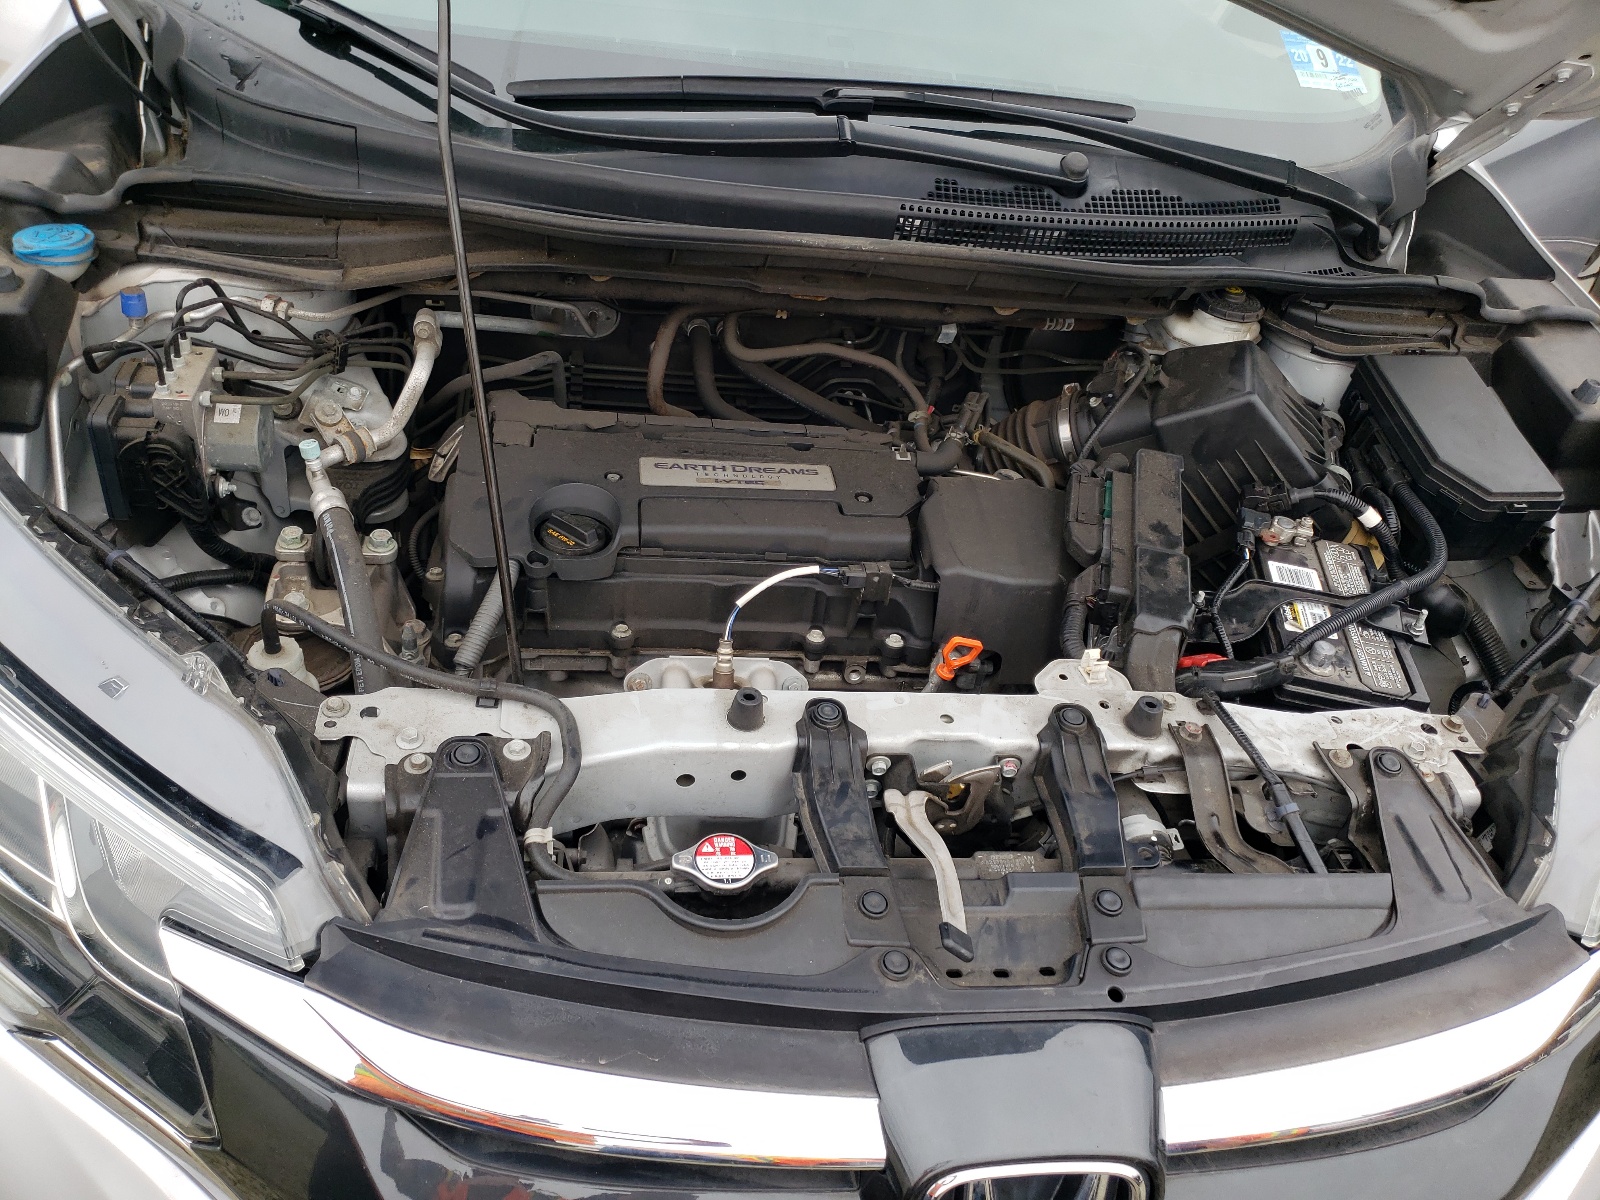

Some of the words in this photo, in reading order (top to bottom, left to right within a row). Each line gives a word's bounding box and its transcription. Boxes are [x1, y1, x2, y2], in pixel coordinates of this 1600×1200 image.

[1290, 48, 1309, 63] 20
[1315, 48, 1329, 68] 9
[654, 461, 726, 473] EARTH
[731, 464, 819, 476] DREAMS
[696, 472, 781, 480] TECHNOLOGY
